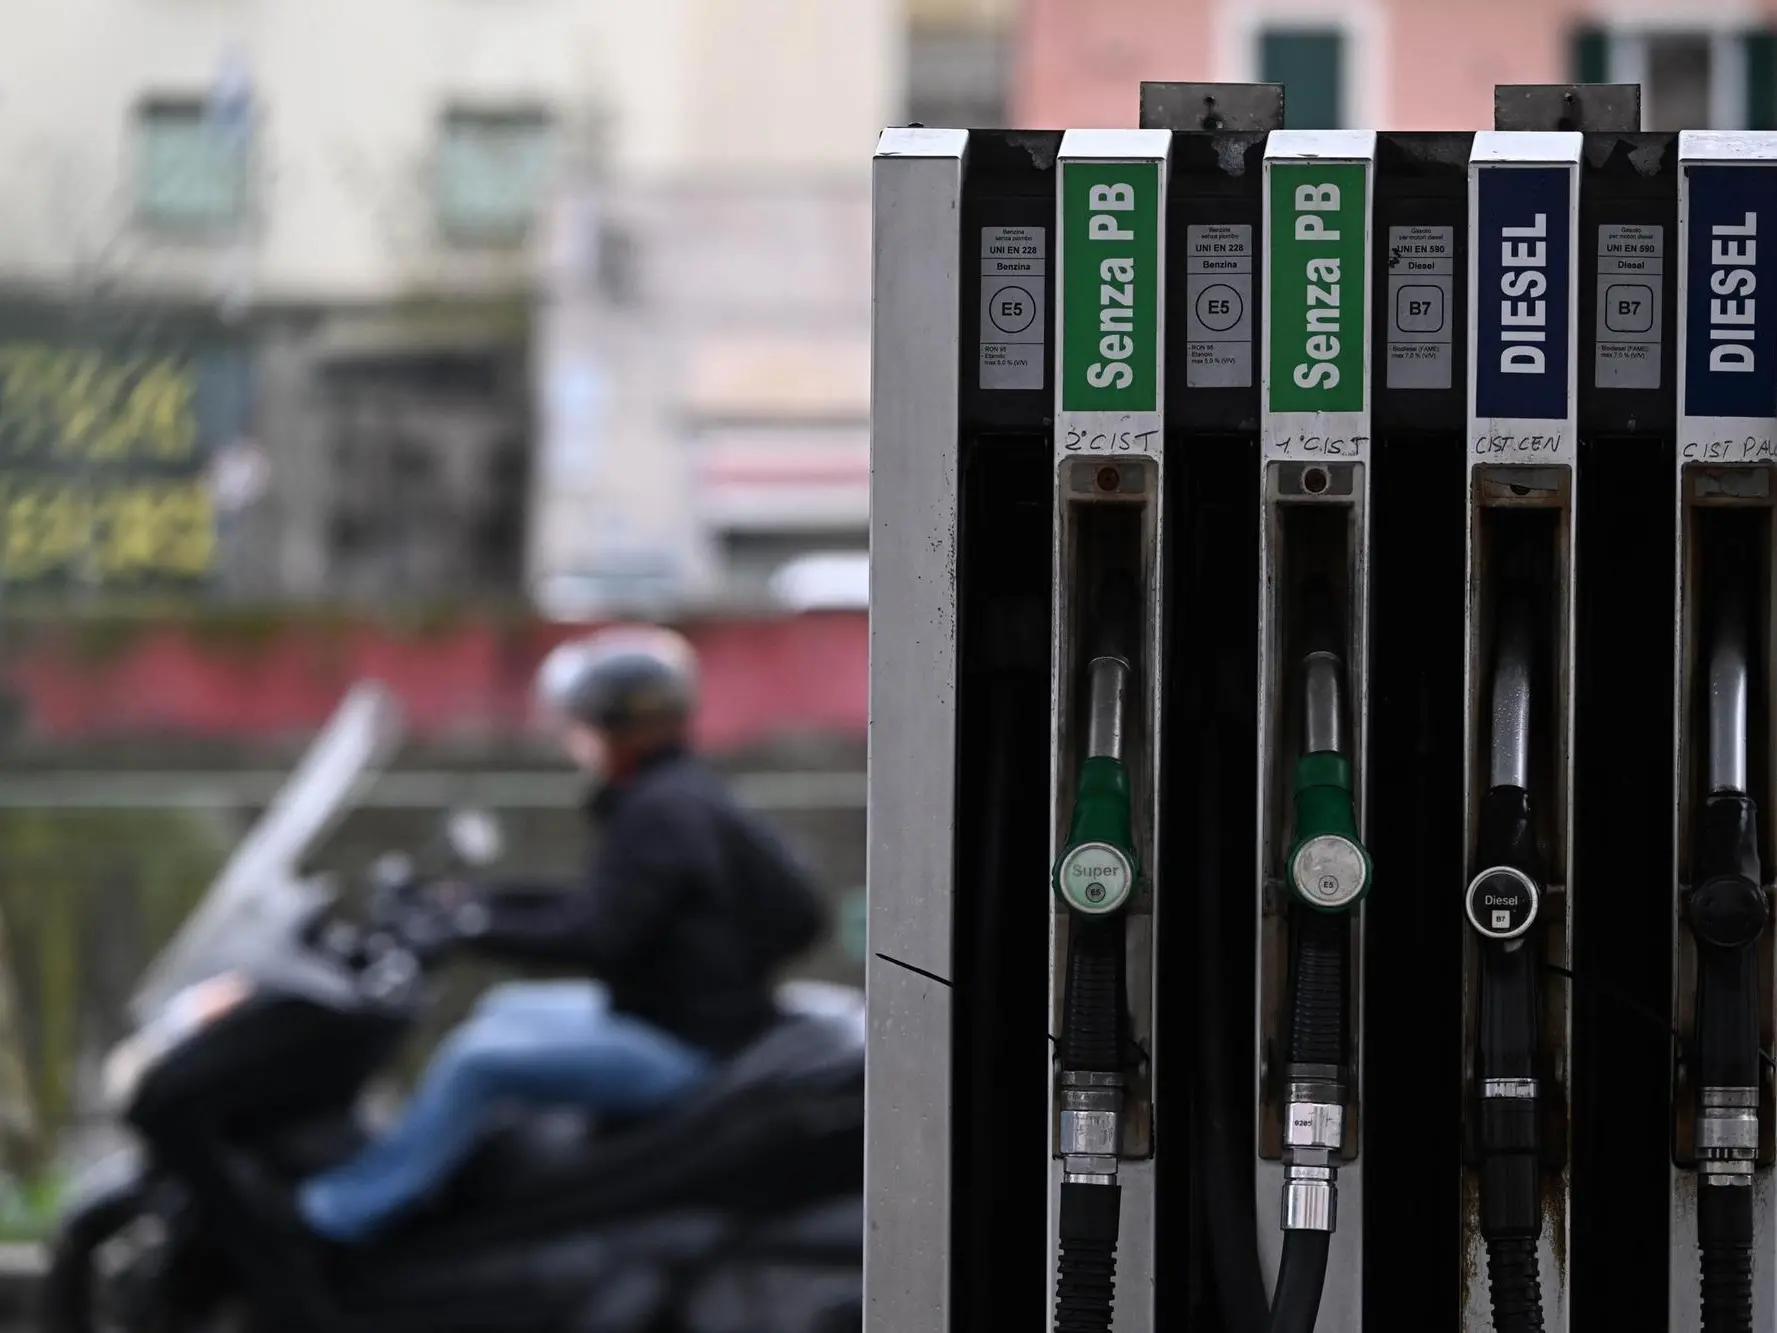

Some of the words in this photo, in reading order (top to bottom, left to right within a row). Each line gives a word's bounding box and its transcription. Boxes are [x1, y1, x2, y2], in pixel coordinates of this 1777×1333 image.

[1088, 183, 1135, 241] PB
[1295, 183, 1340, 241] PB
[990, 246, 1005, 254] UNI
[1007, 246, 1020, 254] EN
[1022, 246, 1037, 254] 228
[1195, 244, 1211, 252] UNI
[1213, 244, 1226, 252] EN
[1228, 244, 1244, 252] 228
[1397, 245, 1413, 253] UNI
[1415, 245, 1428, 253] EN
[1430, 245, 1445, 253] 590
[1606, 244, 1623, 252] UNI
[1624, 244, 1637, 252] EN
[1639, 244, 1655, 253] 590
[996, 262, 1031, 271] Benzina
[1202, 260, 1238, 269] Benzina
[1408, 261, 1435, 270] Diesel
[1617, 260, 1645, 269] Diesel
[1500, 213, 1547, 374] DIESEL
[1709, 212, 1757, 372] DIESEL
[1002, 302, 1023, 316] E5
[1208, 300, 1230, 314] E5
[1410, 301, 1431, 315] B7
[1619, 301, 1641, 315] B7
[1087, 257, 1134, 389] Senza
[1293, 257, 1340, 389] Senza
[1072, 863, 1119, 880] Super
[1323, 881, 1334, 889] E5
[1485, 895, 1518, 906] Diesel
